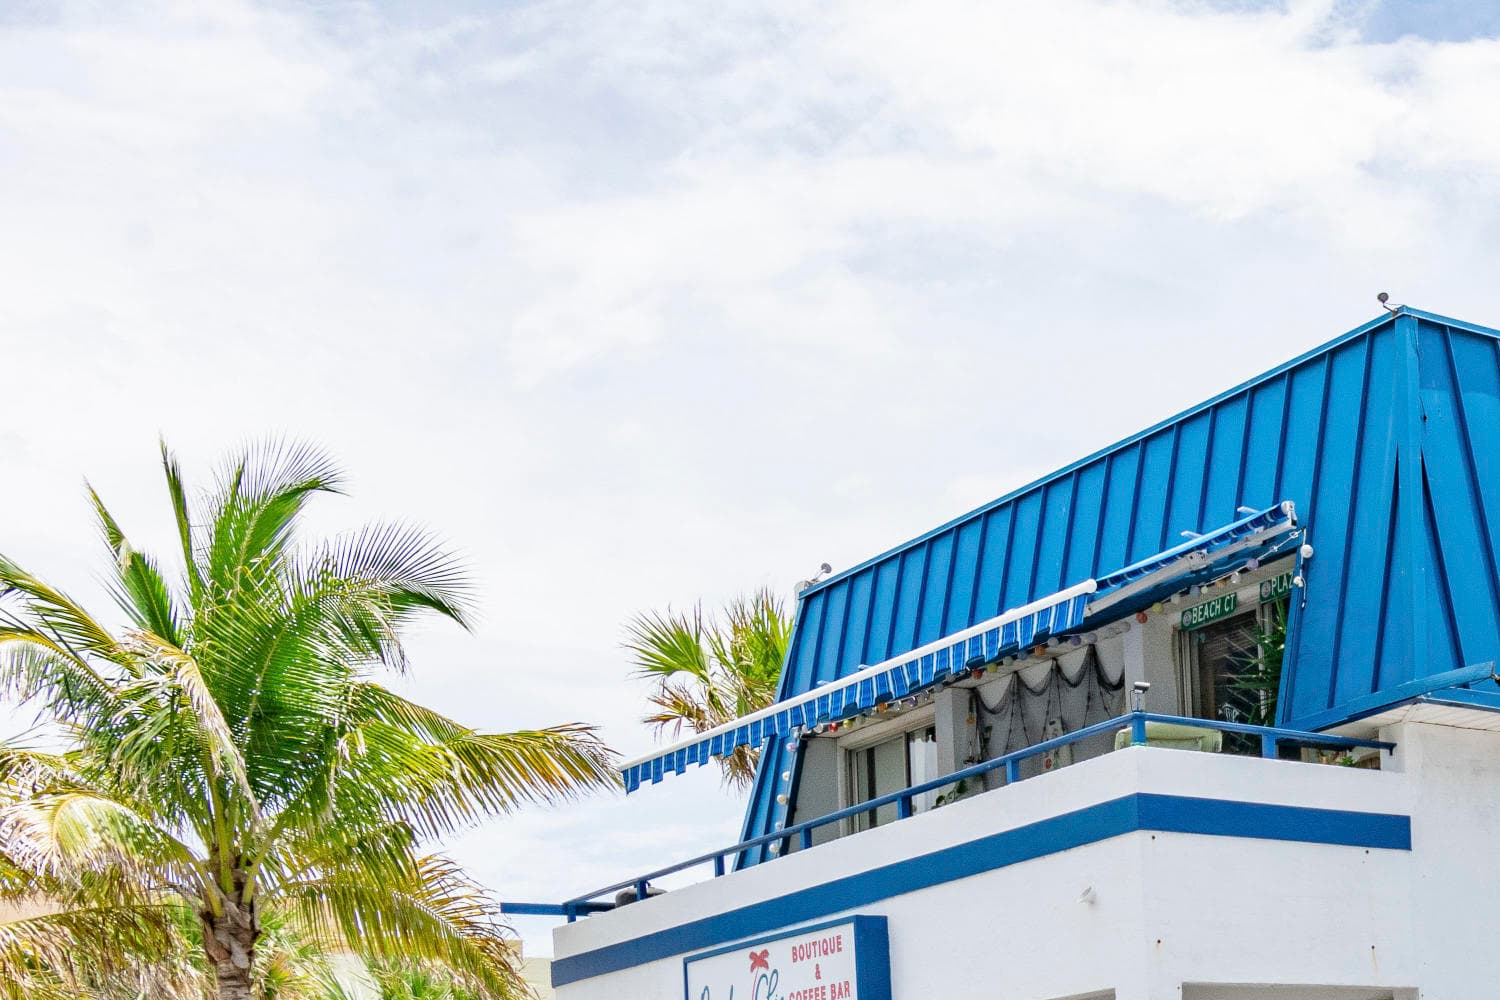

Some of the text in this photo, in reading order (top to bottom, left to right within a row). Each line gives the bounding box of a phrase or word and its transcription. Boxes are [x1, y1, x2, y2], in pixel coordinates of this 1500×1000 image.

[1192, 594, 1235, 624] BEACH CT
[792, 935, 842, 963] BOUTIQUE
[815, 964, 822, 980] &
[830, 981, 851, 1000] BAR
